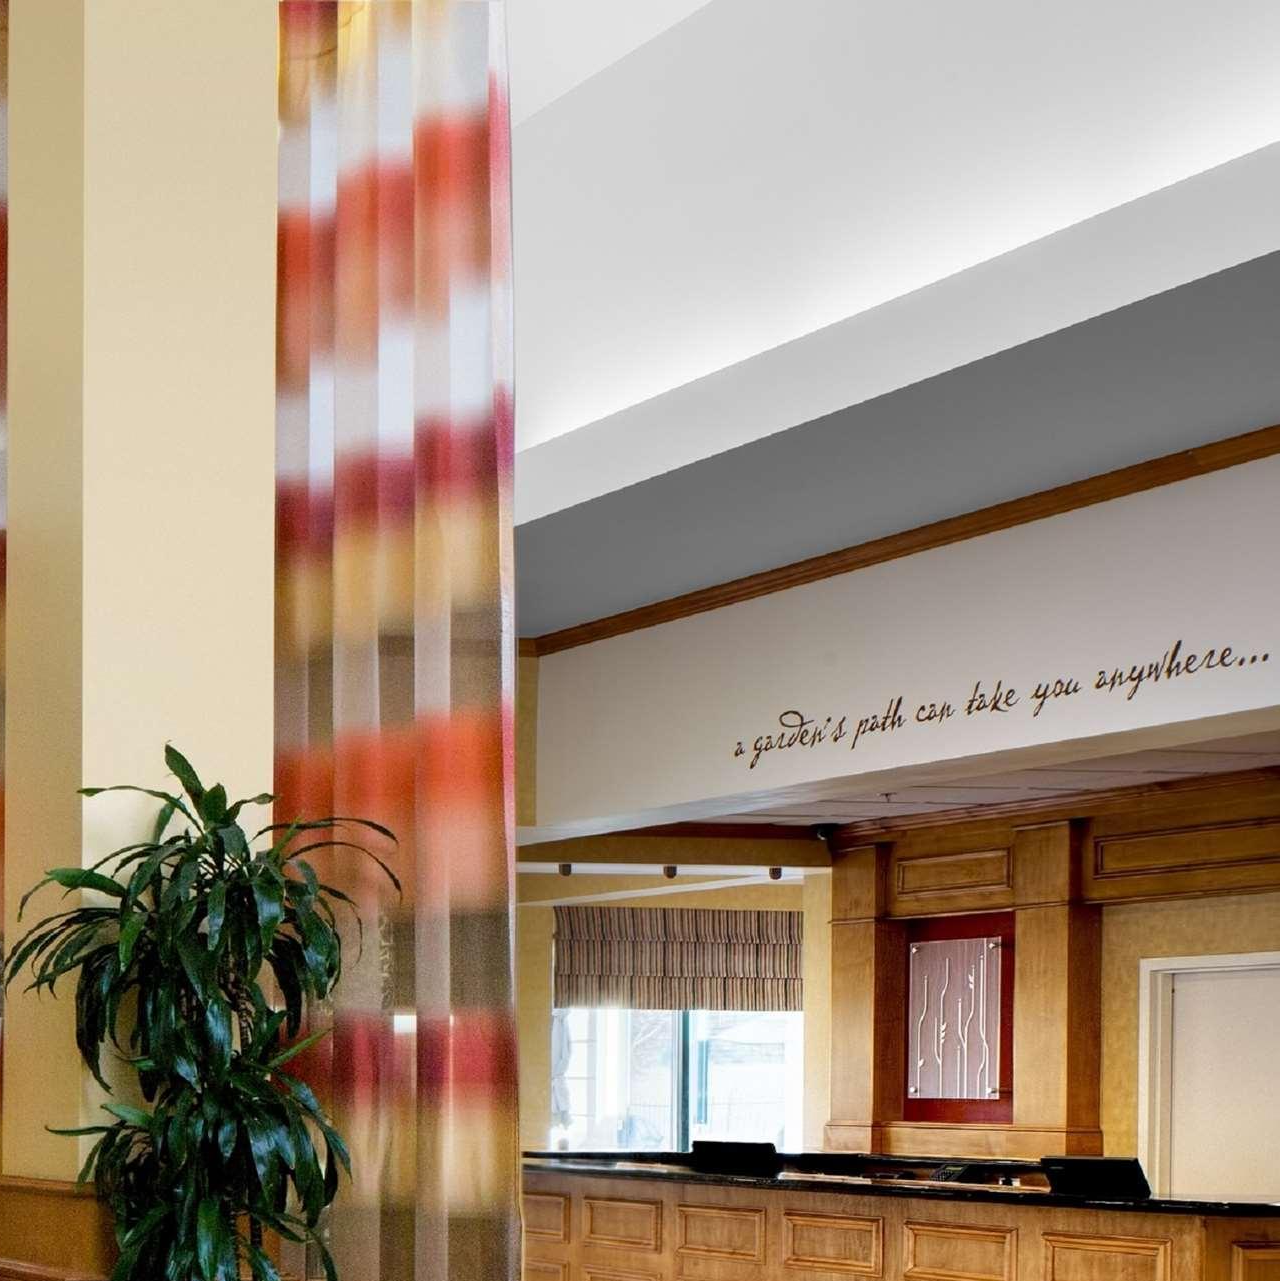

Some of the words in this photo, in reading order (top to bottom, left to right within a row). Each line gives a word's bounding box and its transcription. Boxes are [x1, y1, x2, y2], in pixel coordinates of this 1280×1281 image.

[734, 741, 745, 757] a
[750, 710, 846, 769] garden's
[851, 696, 907, 749] path
[916, 701, 955, 723] can
[965, 679, 1020, 716] take
[1030, 677, 1081, 717] you
